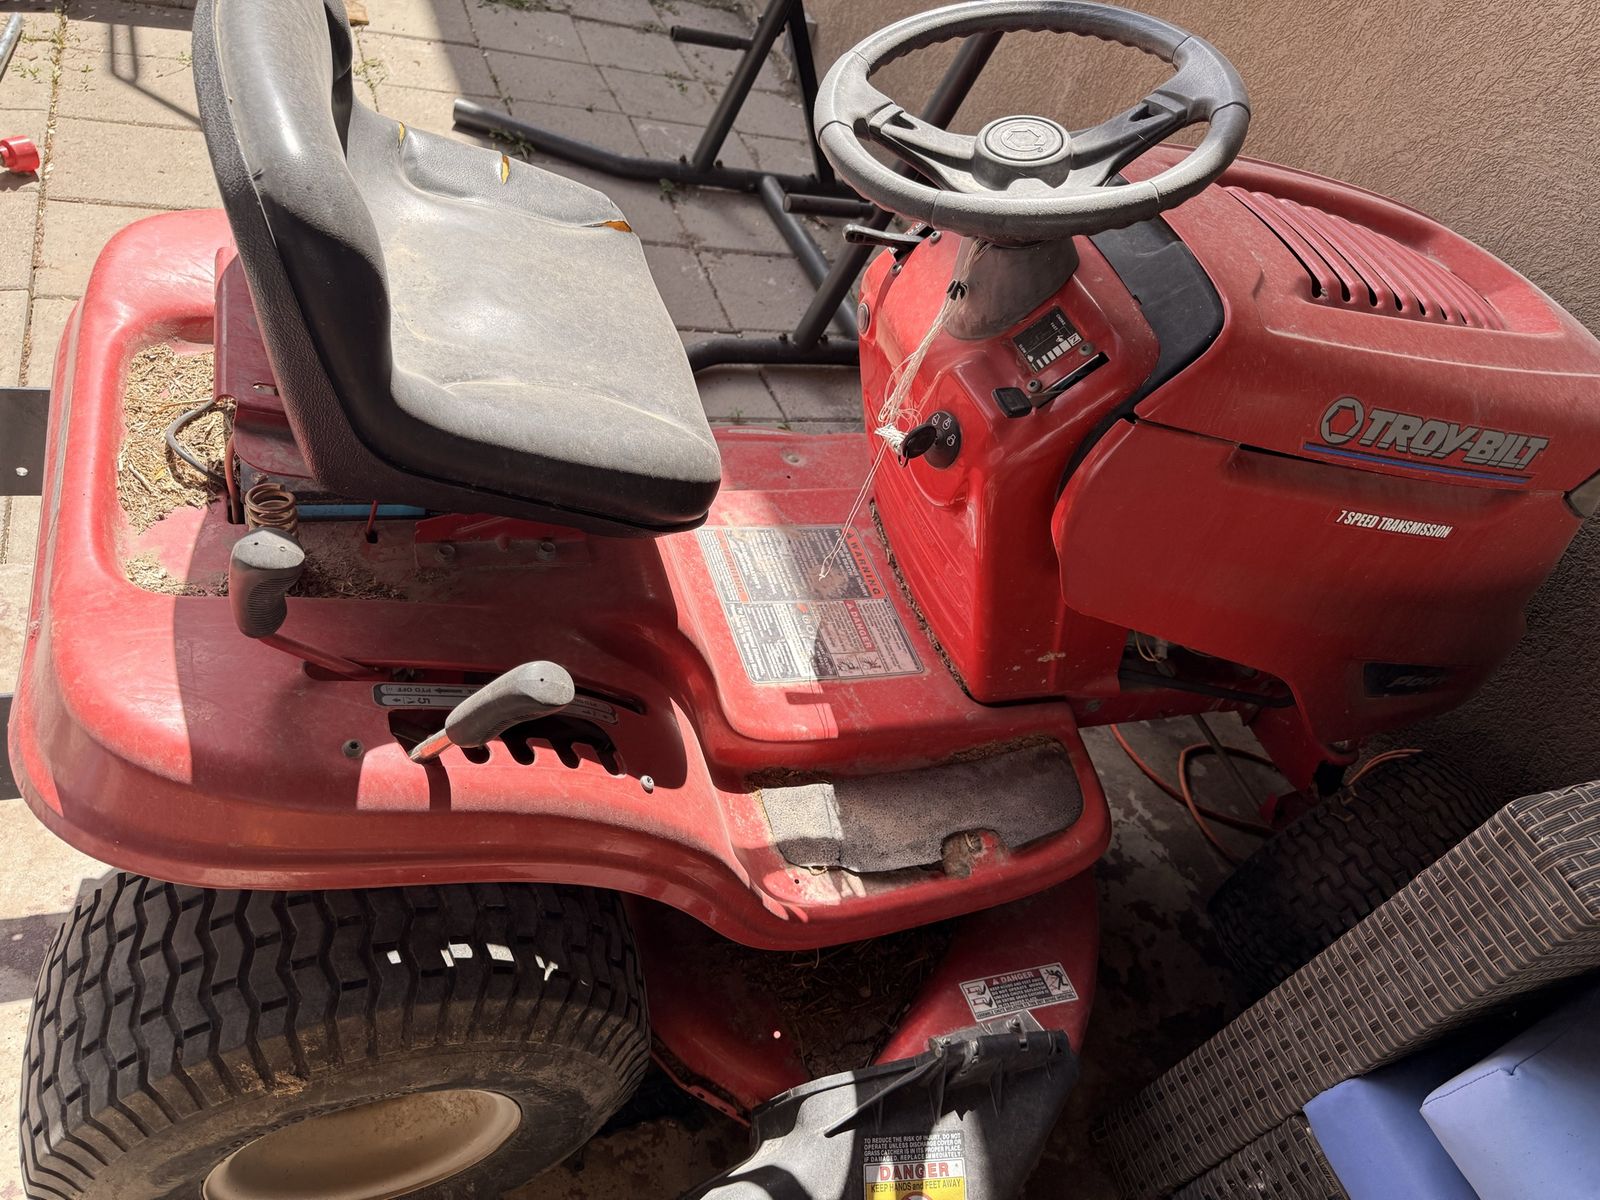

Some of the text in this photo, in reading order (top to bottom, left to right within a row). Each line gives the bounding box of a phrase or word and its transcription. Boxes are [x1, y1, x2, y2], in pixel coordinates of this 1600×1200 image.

[1359, 407, 1550, 470] TROY-BILT
[1336, 510, 1453, 538] 7 SPEED TRANSMISSION
[848, 542, 882, 595] WARNING
[855, 577, 870, 596] INJURY
[849, 611, 872, 648] DANGER
[999, 971, 1034, 983] DANGER
[879, 1162, 949, 1180] DANGER
[871, 1178, 961, 1193] KEEP HANDS and FEET AWAY
